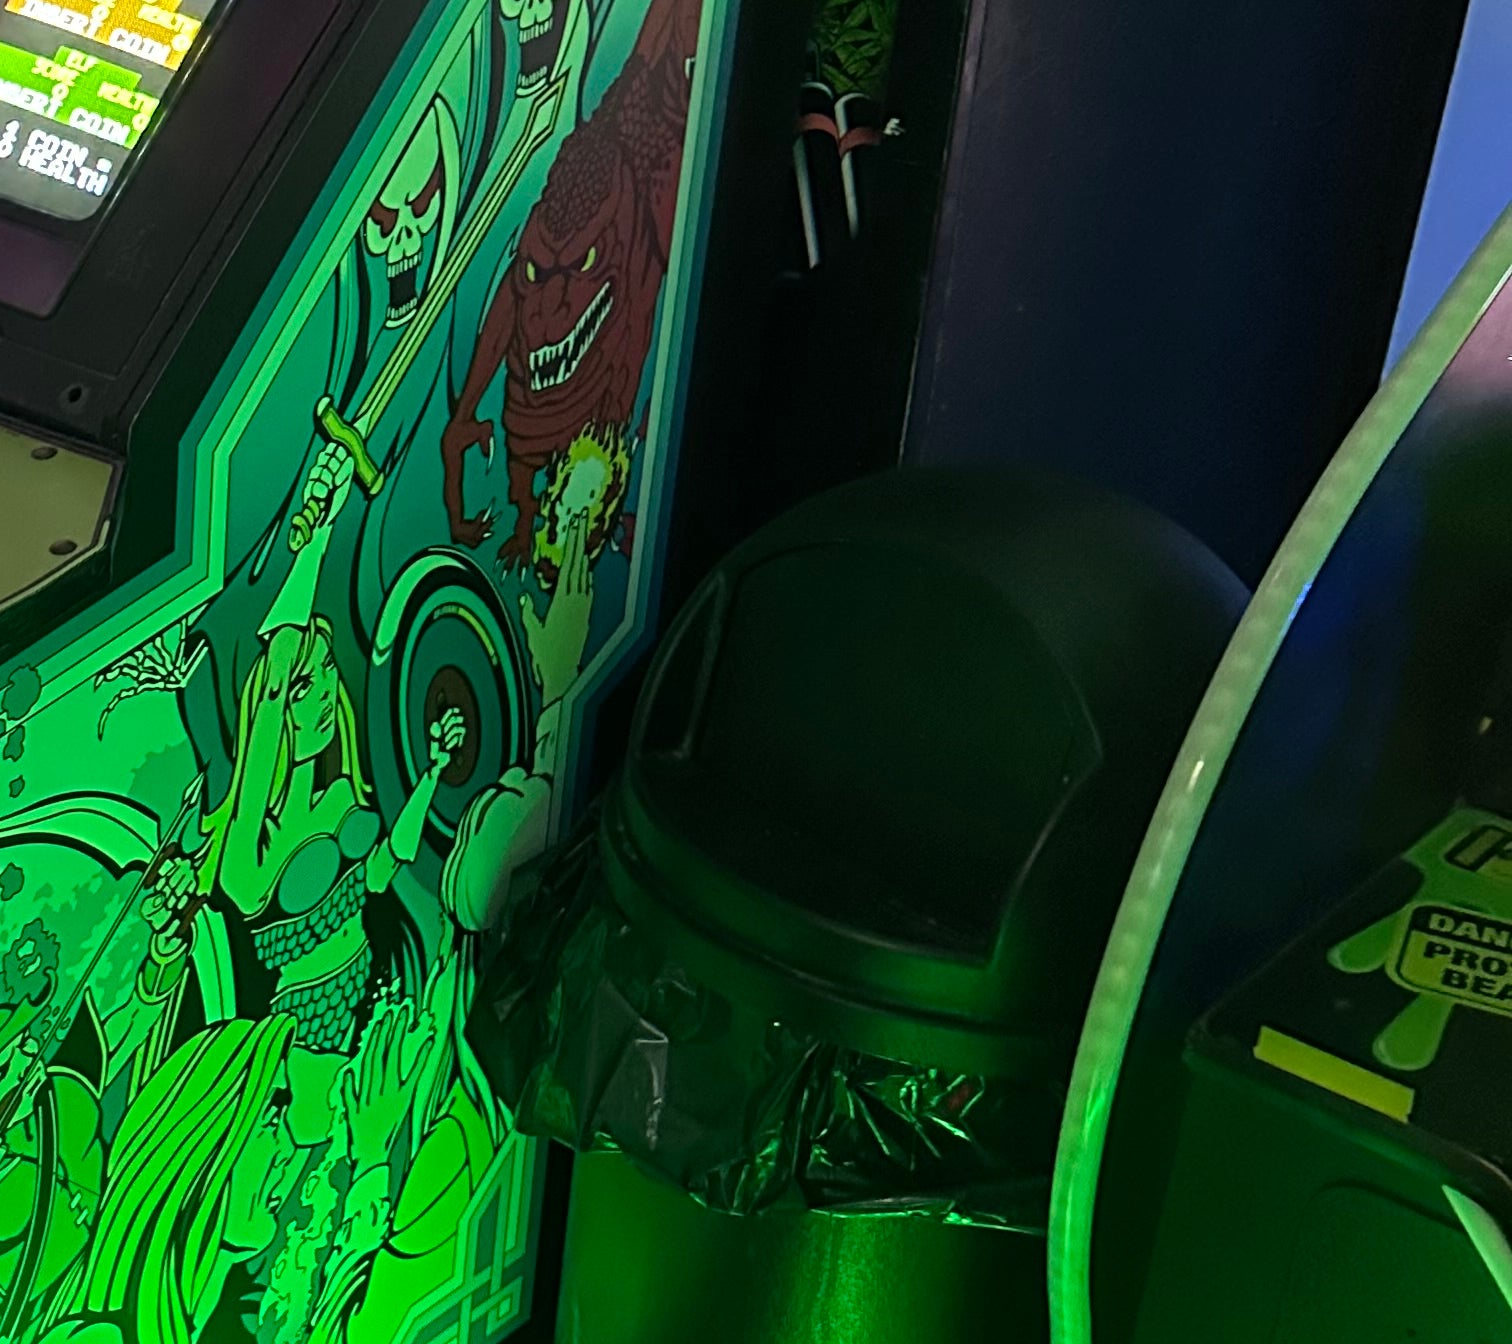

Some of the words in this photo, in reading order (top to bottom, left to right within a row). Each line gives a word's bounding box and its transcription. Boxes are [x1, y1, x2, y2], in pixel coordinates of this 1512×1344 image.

[108, 27, 173, 66] COIN
[67, 106, 131, 146] COIN
[26, 128, 90, 168] COIN
[18, 146, 109, 197] HEALTH
